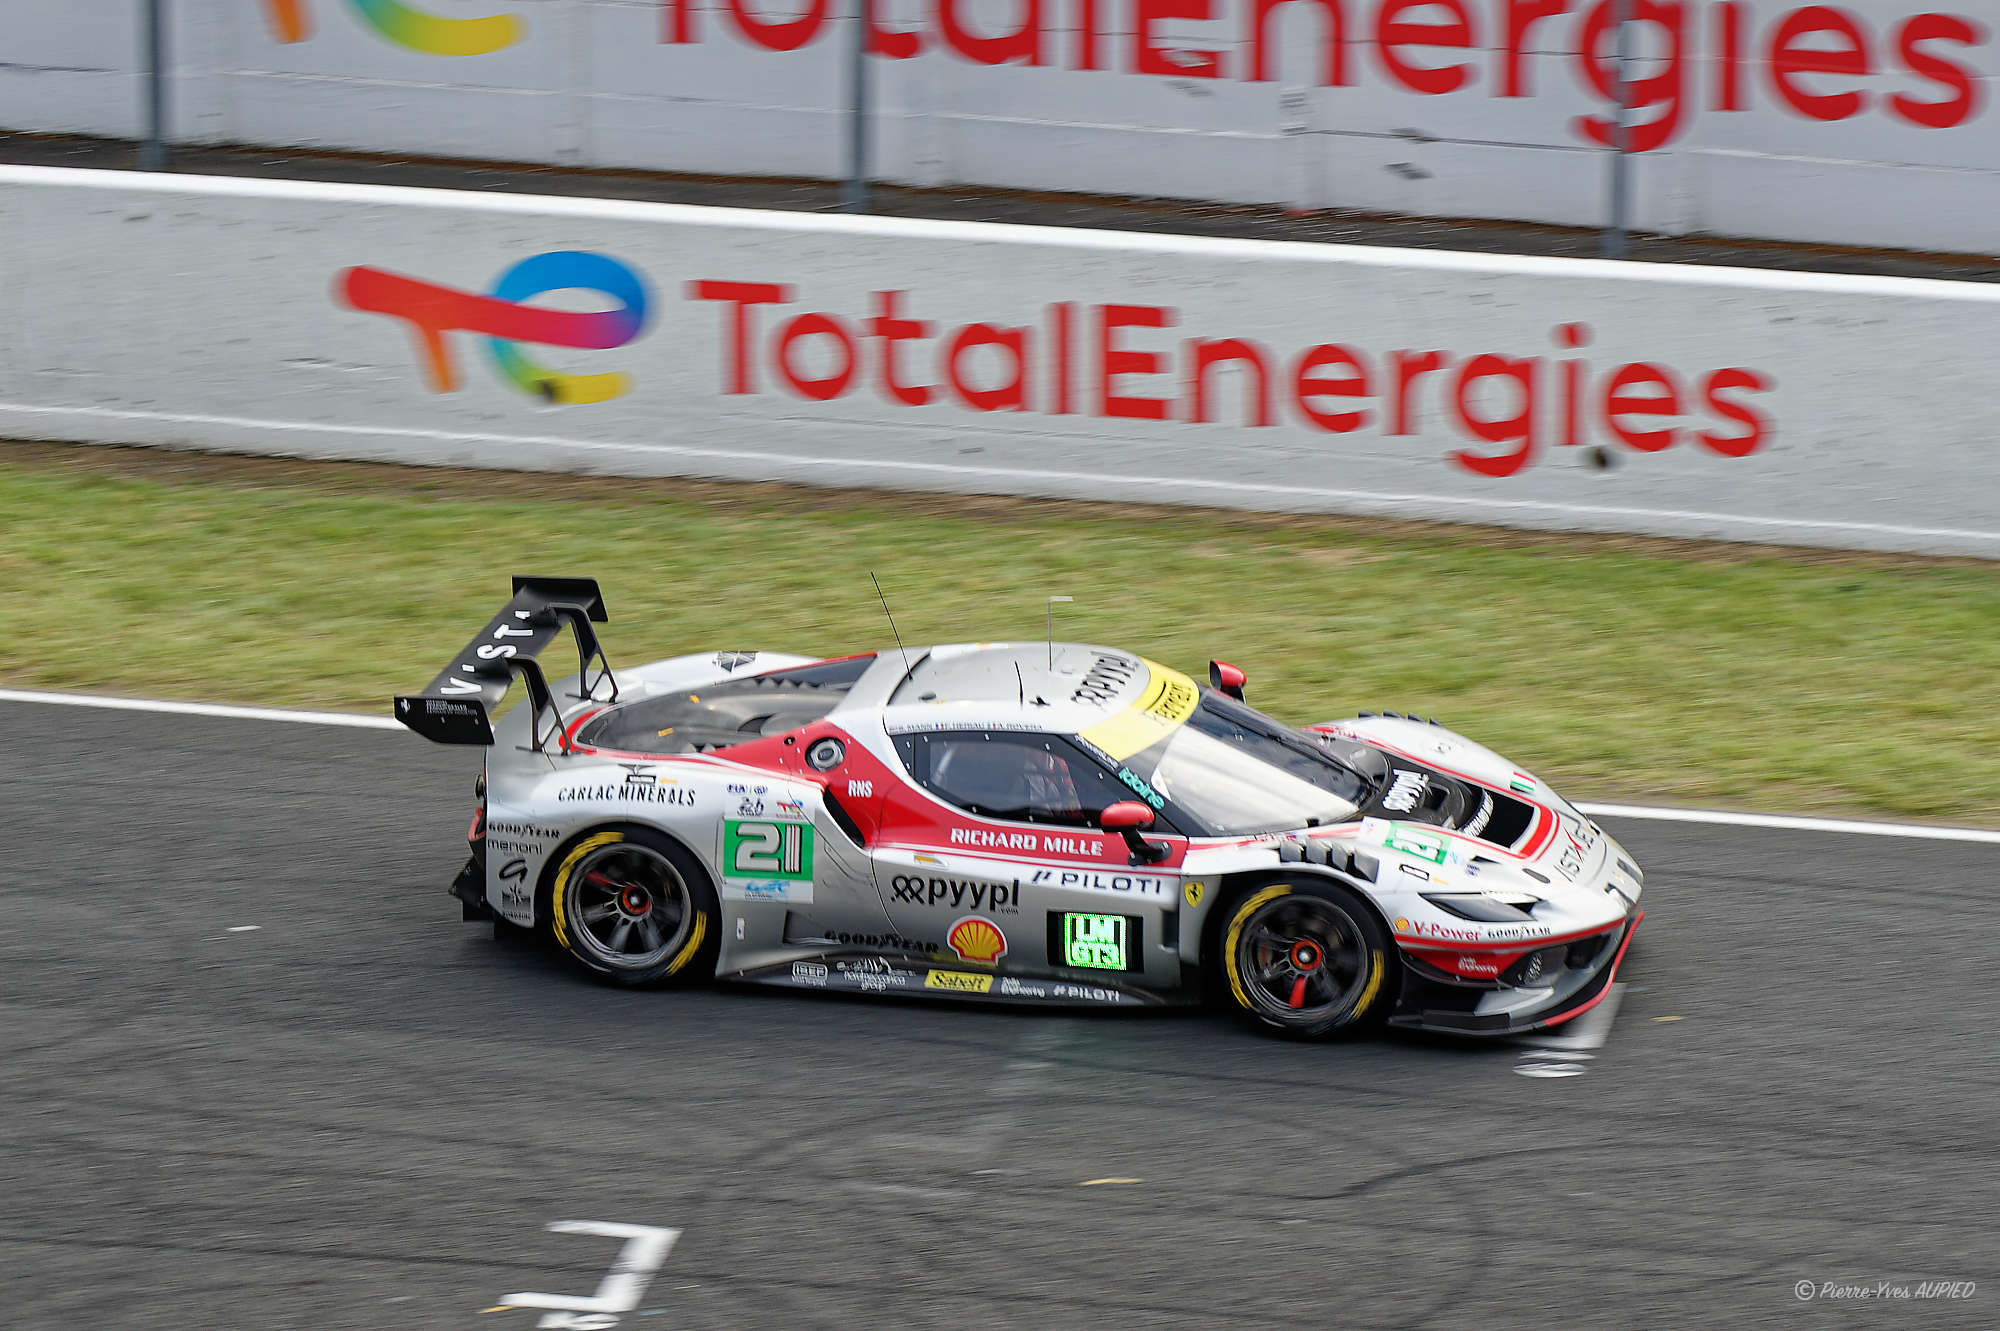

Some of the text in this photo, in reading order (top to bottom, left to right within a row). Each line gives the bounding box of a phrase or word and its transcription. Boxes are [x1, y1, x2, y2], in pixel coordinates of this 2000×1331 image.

[684, 280, 1777, 477] TotalEnergies
[558, 784, 696, 807] CARLAC MINERALS
[848, 780, 873, 797] RNS
[489, 821, 560, 838] GOODYEAR
[735, 822, 802, 873] 21
[951, 827, 1104, 857] RICHARD MILLE
[1061, 872, 1161, 894] PILOTI
[928, 877, 1019, 913] pyypl
[824, 930, 939, 953] GOODYEAR
[1487, 925, 1552, 939] GOODYEAR
[1068, 986, 1120, 1002] PILOTI
